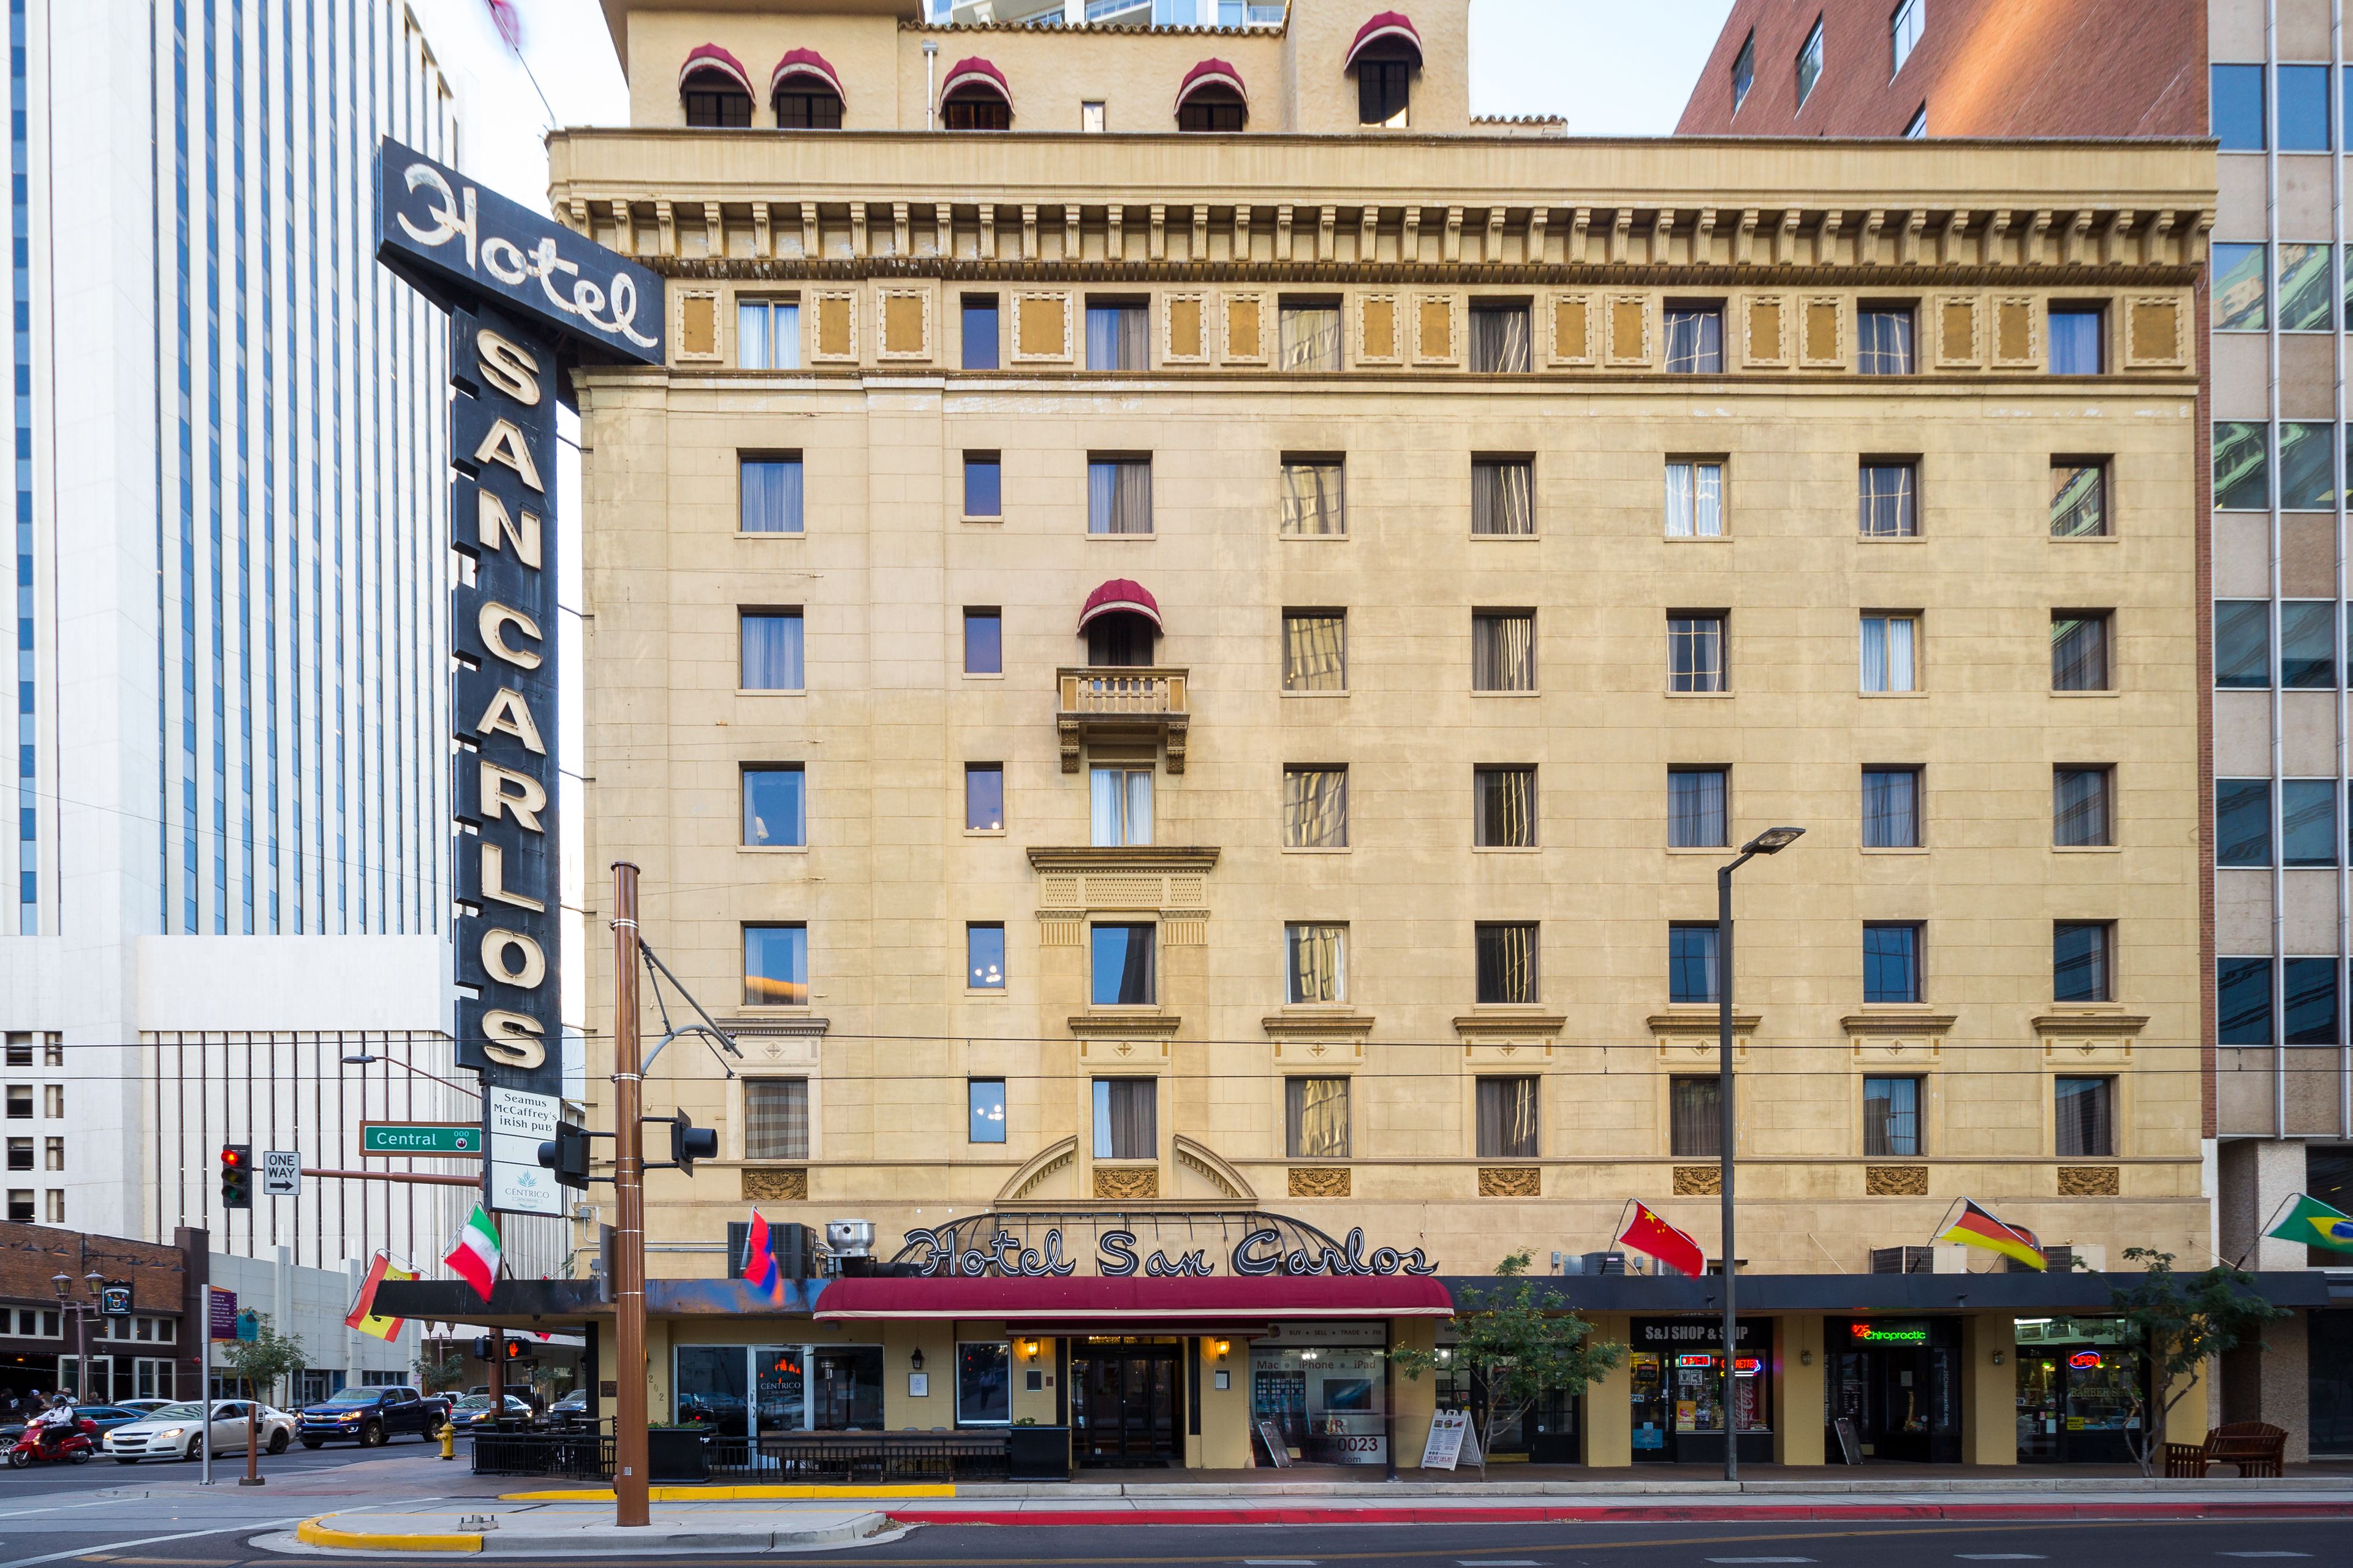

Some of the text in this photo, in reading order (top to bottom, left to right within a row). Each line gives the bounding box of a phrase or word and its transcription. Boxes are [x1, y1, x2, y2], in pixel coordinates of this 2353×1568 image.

[397, 163, 658, 348] Hotel
[504, 1093, 547, 1107] Seamus
[494, 1104, 557, 1121] McCaffrey's
[377, 1132, 436, 1145] Central
[269, 1154, 295, 1165] ONE
[268, 1167, 295, 1178] WAY
[505, 1187, 550, 1199] CÉNTRICO
[904, 1226, 1440, 1278] Hotel San Carlos
[1645, 1326, 1748, 1339] S&J SHOP & SIP
[1852, 1324, 1870, 1337] $25
[1864, 1331, 1926, 1341] Chiropractic
[1257, 1360, 1376, 1369] Mac iPhone iPad
[1681, 1356, 1710, 1366] OPEN
[2069, 1355, 2100, 1366] OPEN
[2071, 1388, 2109, 1397] BARBER
